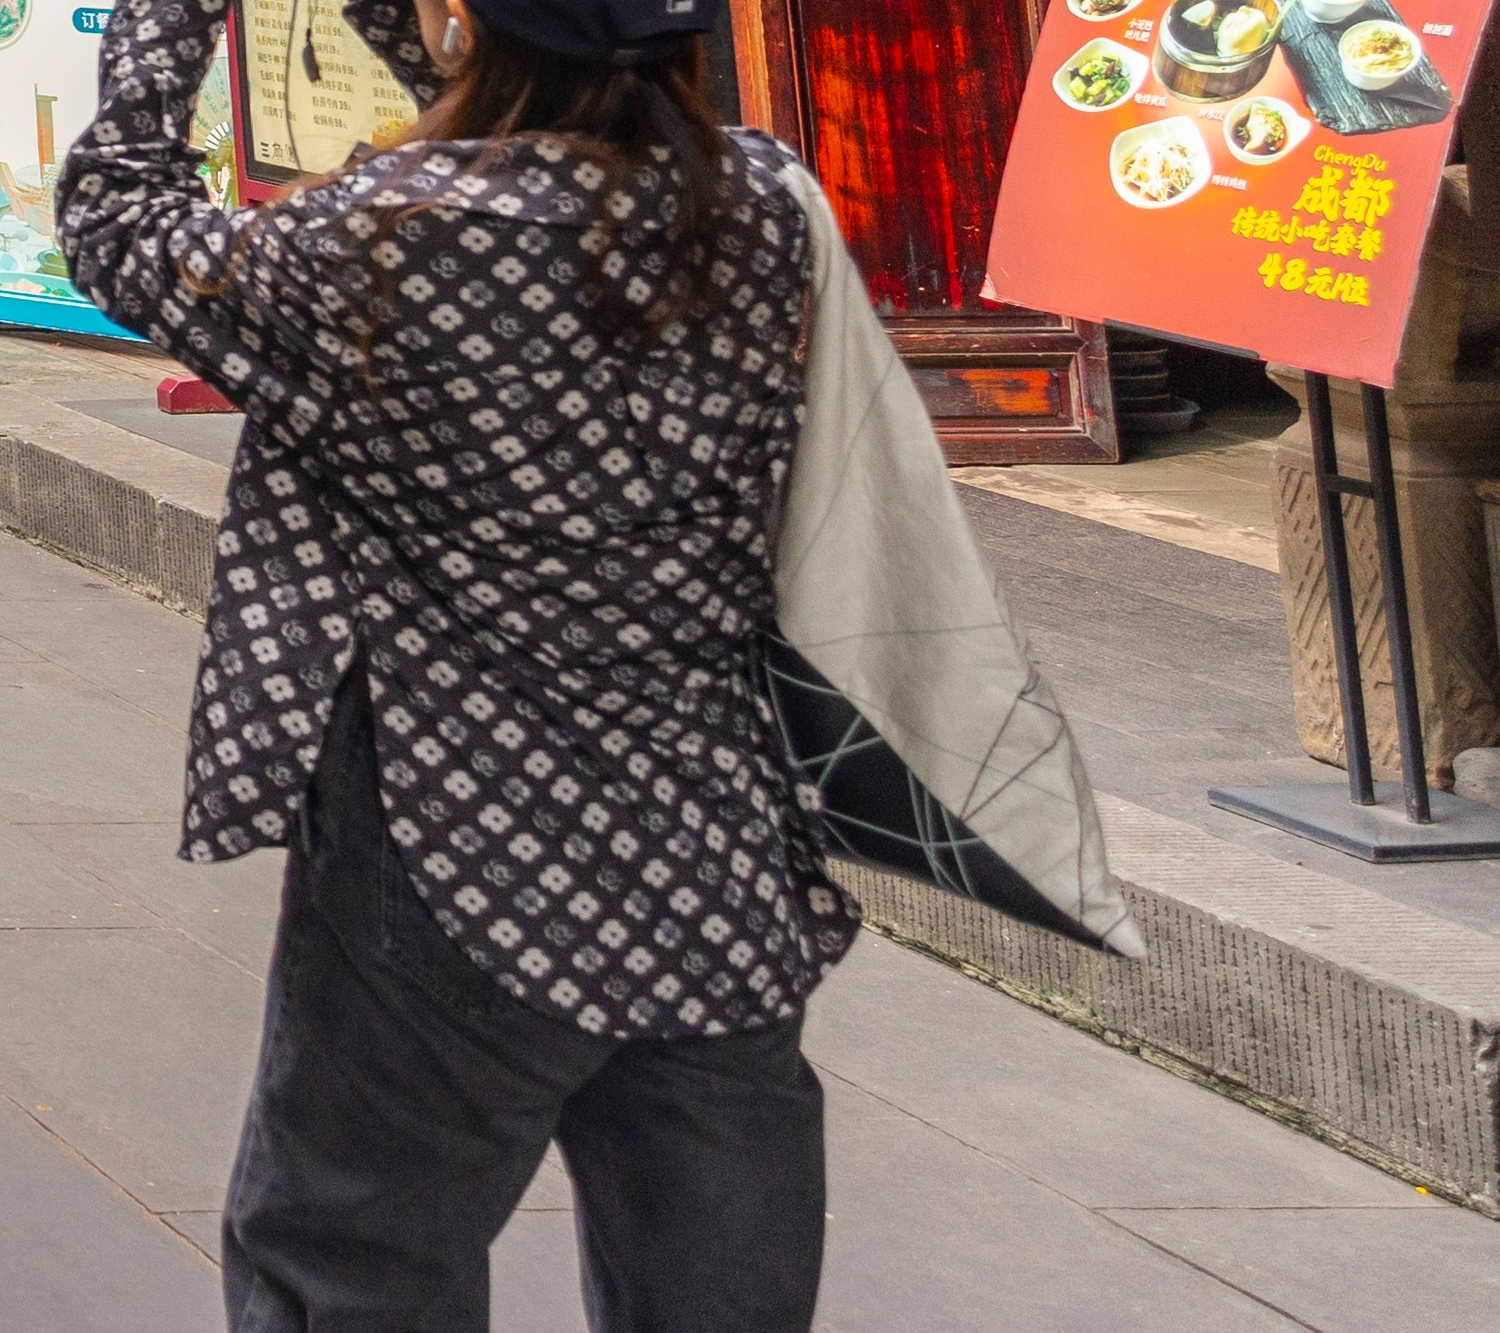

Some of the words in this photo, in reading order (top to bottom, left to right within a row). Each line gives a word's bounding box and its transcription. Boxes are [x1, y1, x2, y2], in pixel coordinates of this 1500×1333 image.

[1314, 145, 1388, 175] ChengDu
[1293, 165, 1395, 227] 成都
[1231, 206, 1383, 261] 传统小吃套餐
[1258, 253, 1370, 307] 48元/位
